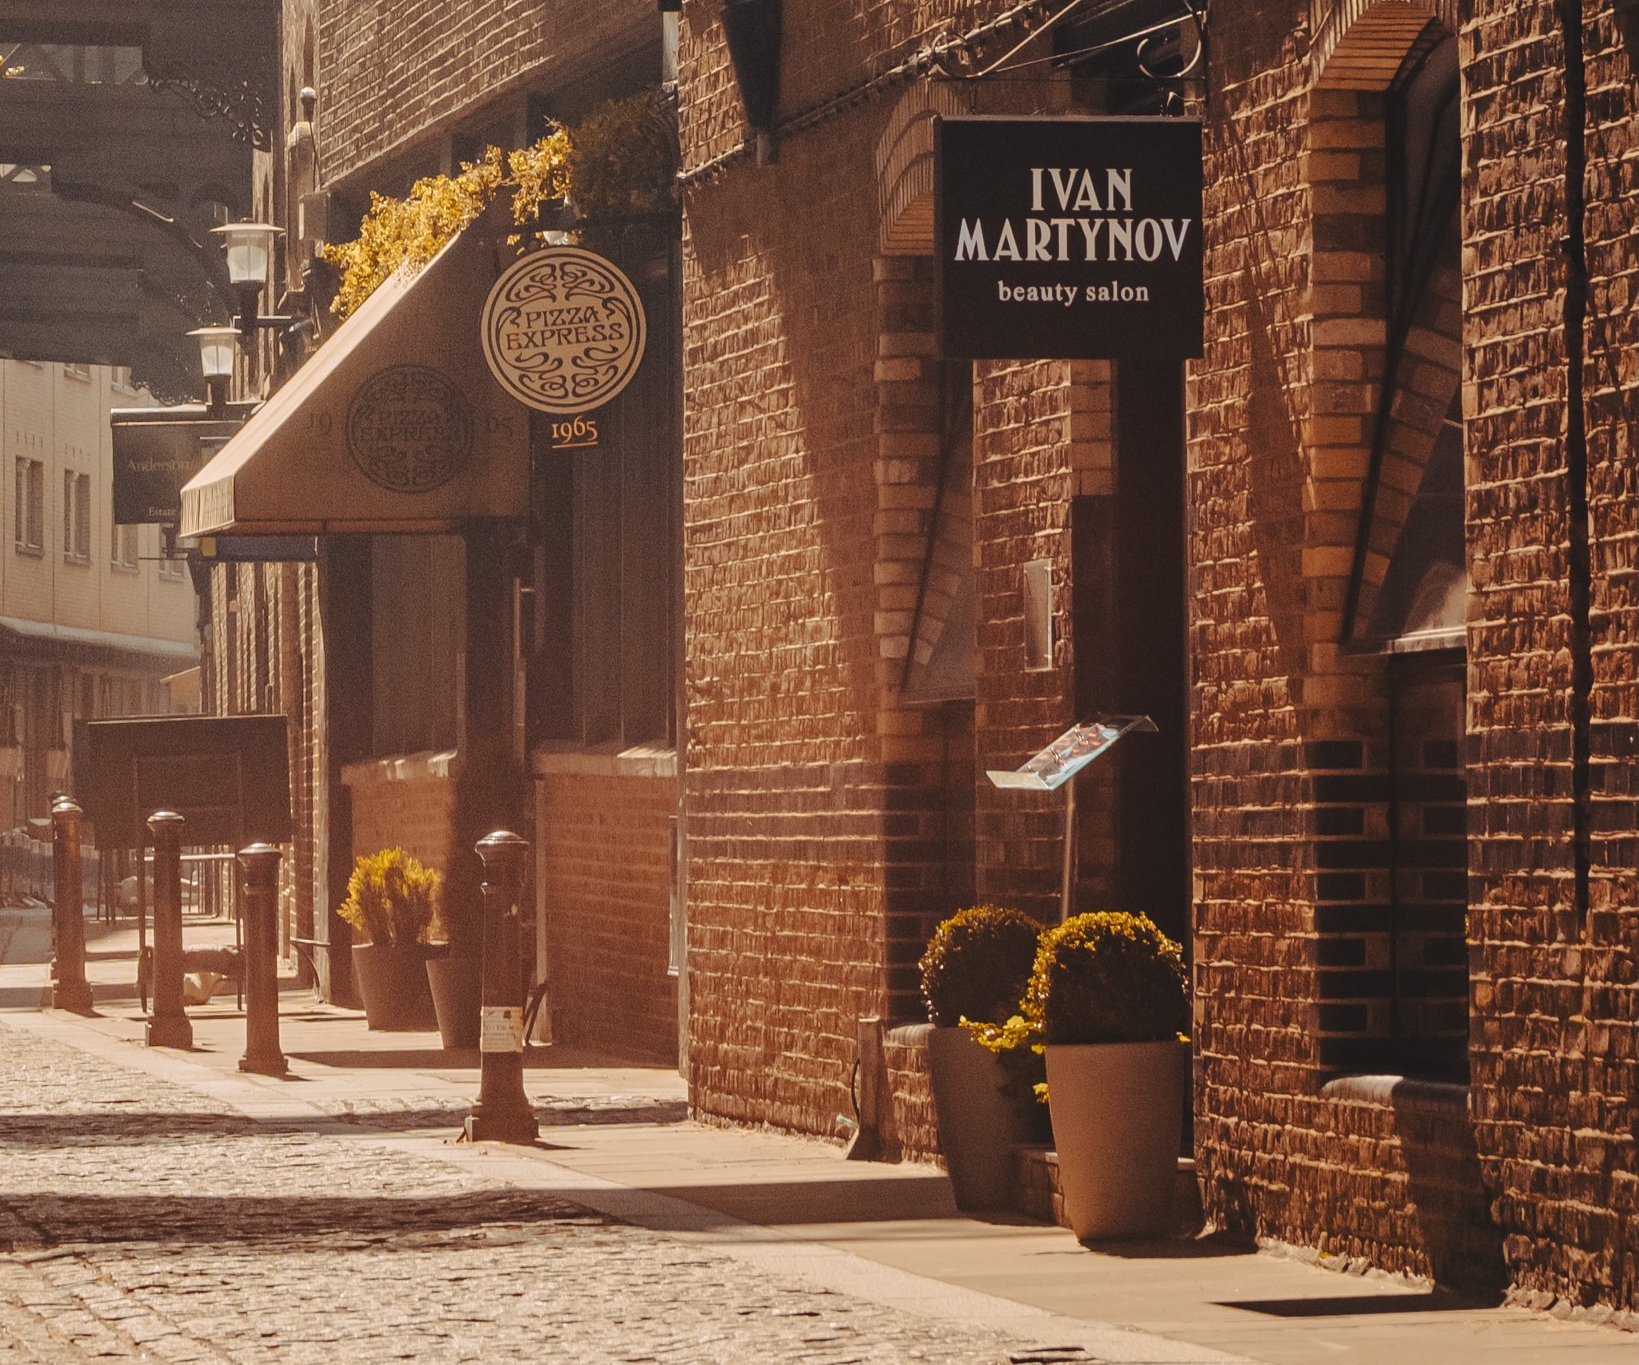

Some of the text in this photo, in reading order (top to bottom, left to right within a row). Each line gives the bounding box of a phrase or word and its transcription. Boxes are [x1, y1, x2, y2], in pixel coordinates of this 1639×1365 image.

[1030, 167, 1133, 212] IVAN
[954, 217, 1192, 262] MARTYNOV
[998, 280, 1150, 306] beauty salon
[525, 306, 599, 329] PIZZA
[505, 322, 625, 351] EXPRESS
[379, 409, 440, 425] PIZZA
[551, 415, 599, 443] 1965
[148, 506, 176, 517] Estate
